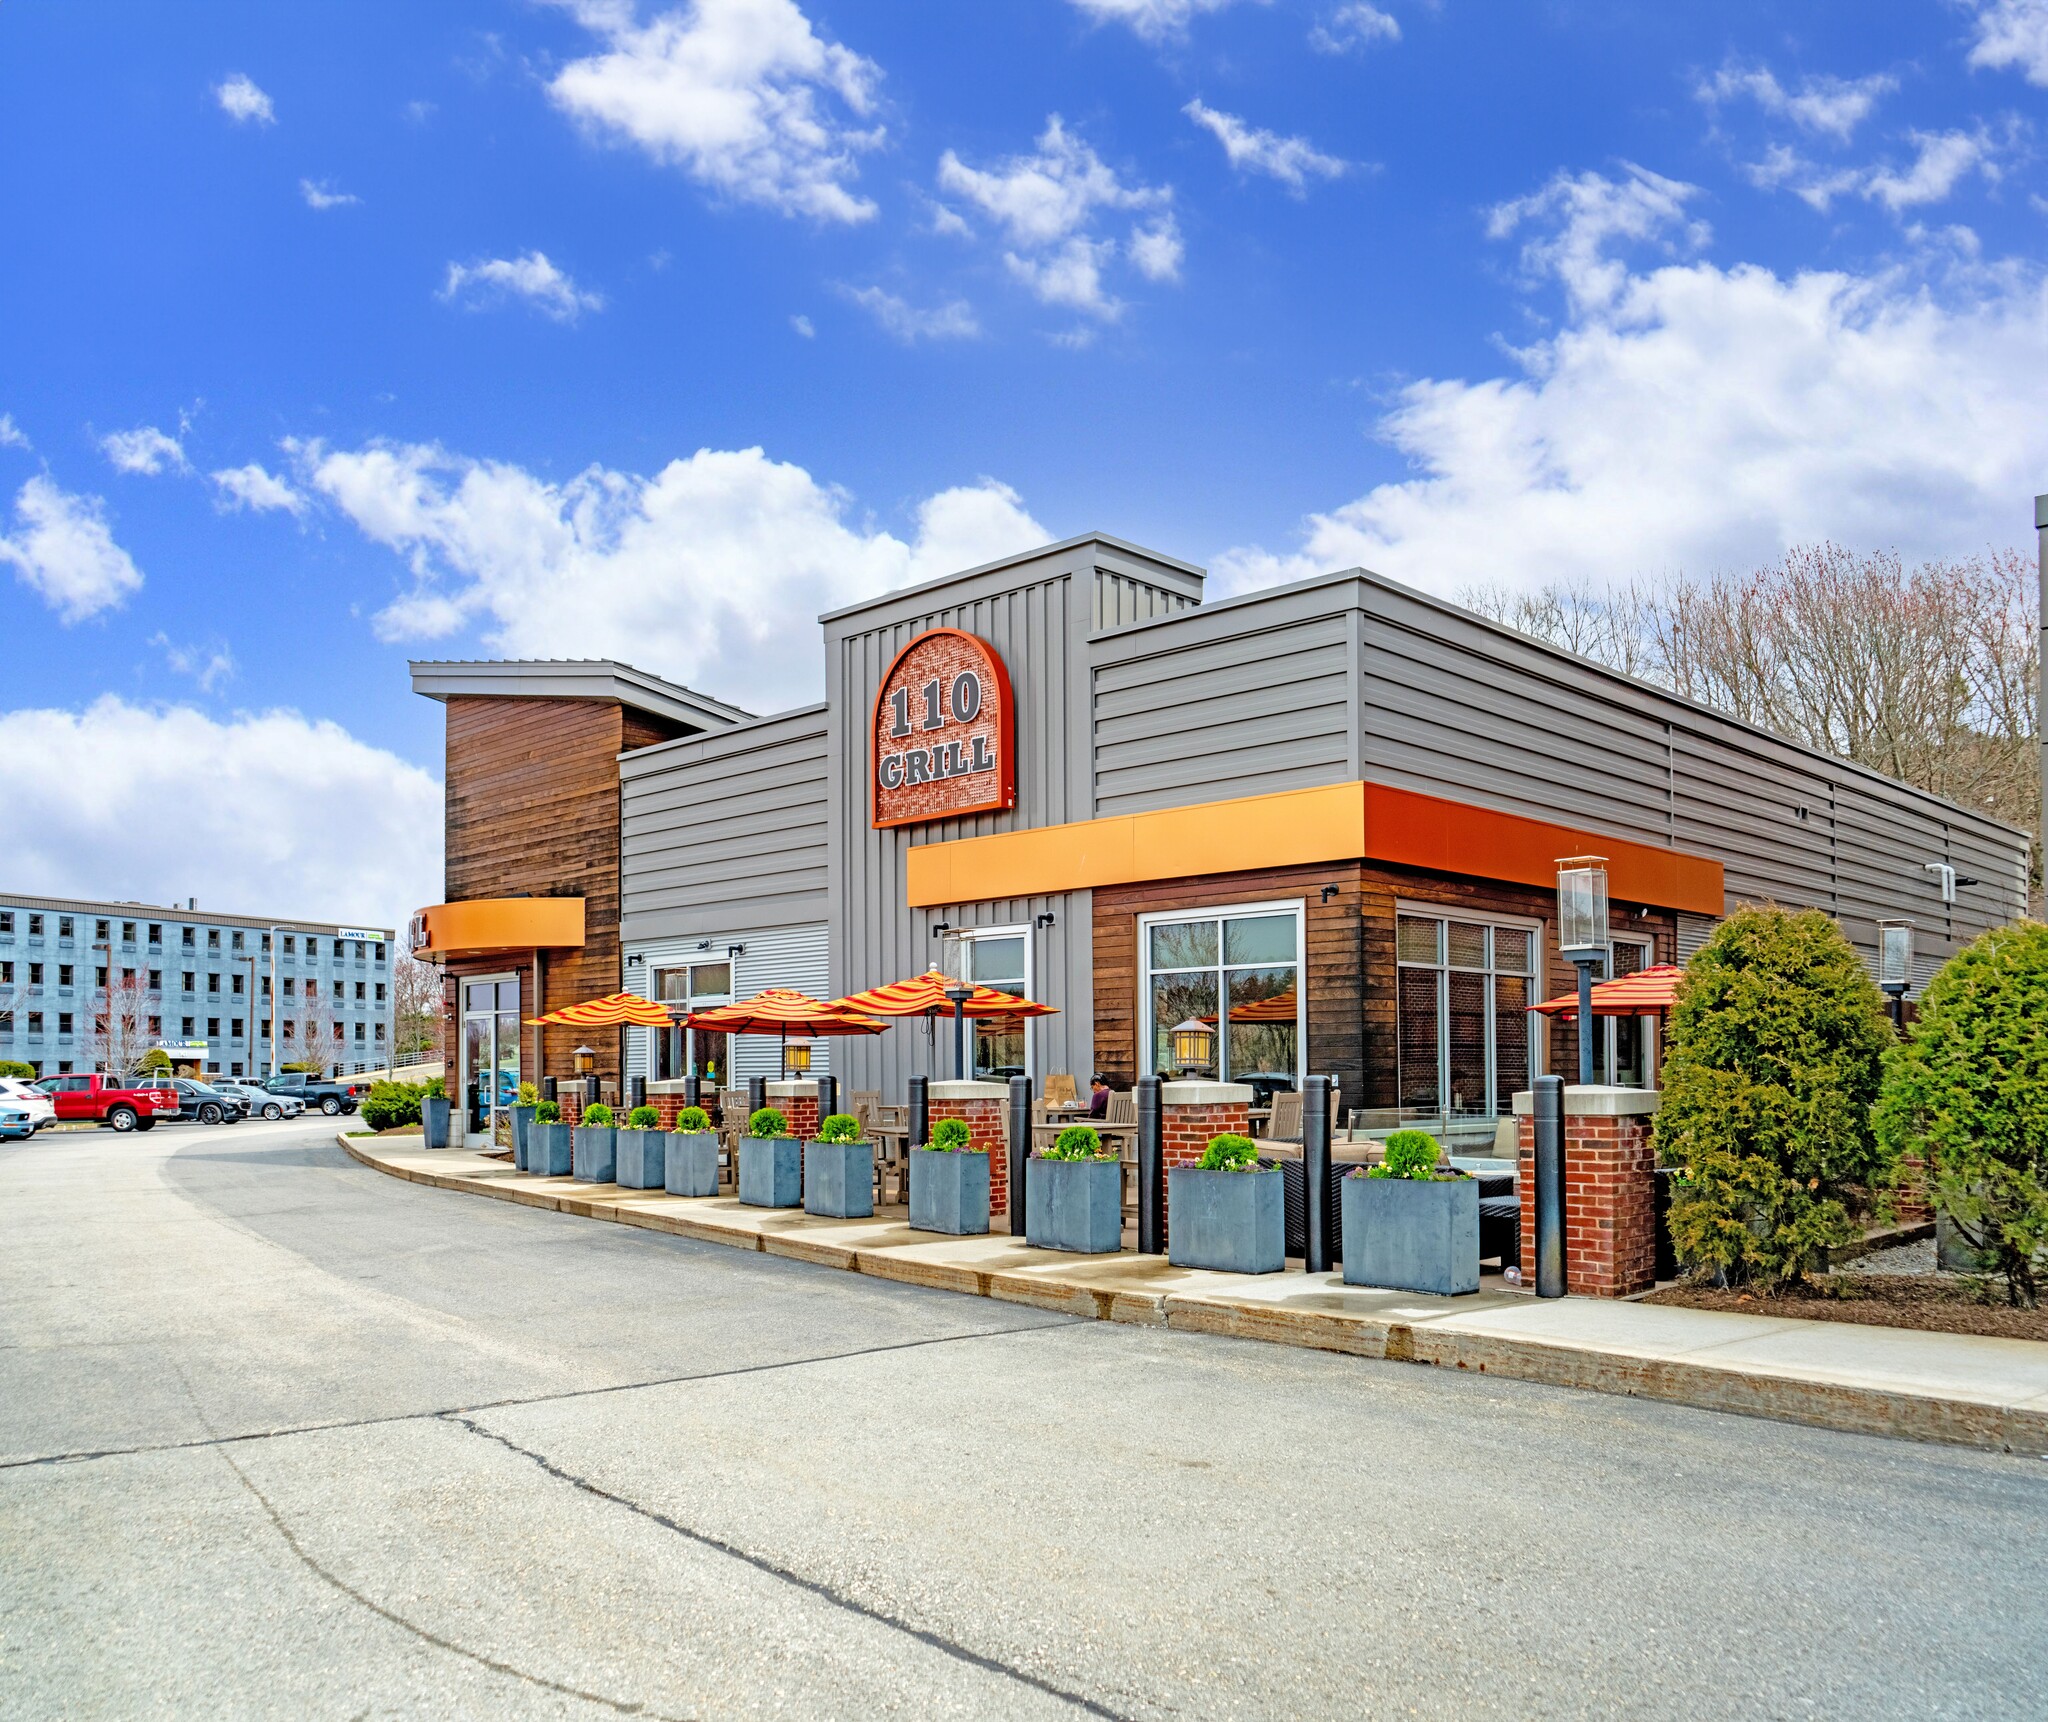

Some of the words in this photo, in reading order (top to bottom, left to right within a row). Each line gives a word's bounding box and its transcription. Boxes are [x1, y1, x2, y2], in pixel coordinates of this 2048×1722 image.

[890, 671, 981, 738] 110
[879, 735, 996, 790] GRILL
[340, 930, 366, 939] LAMOUR
